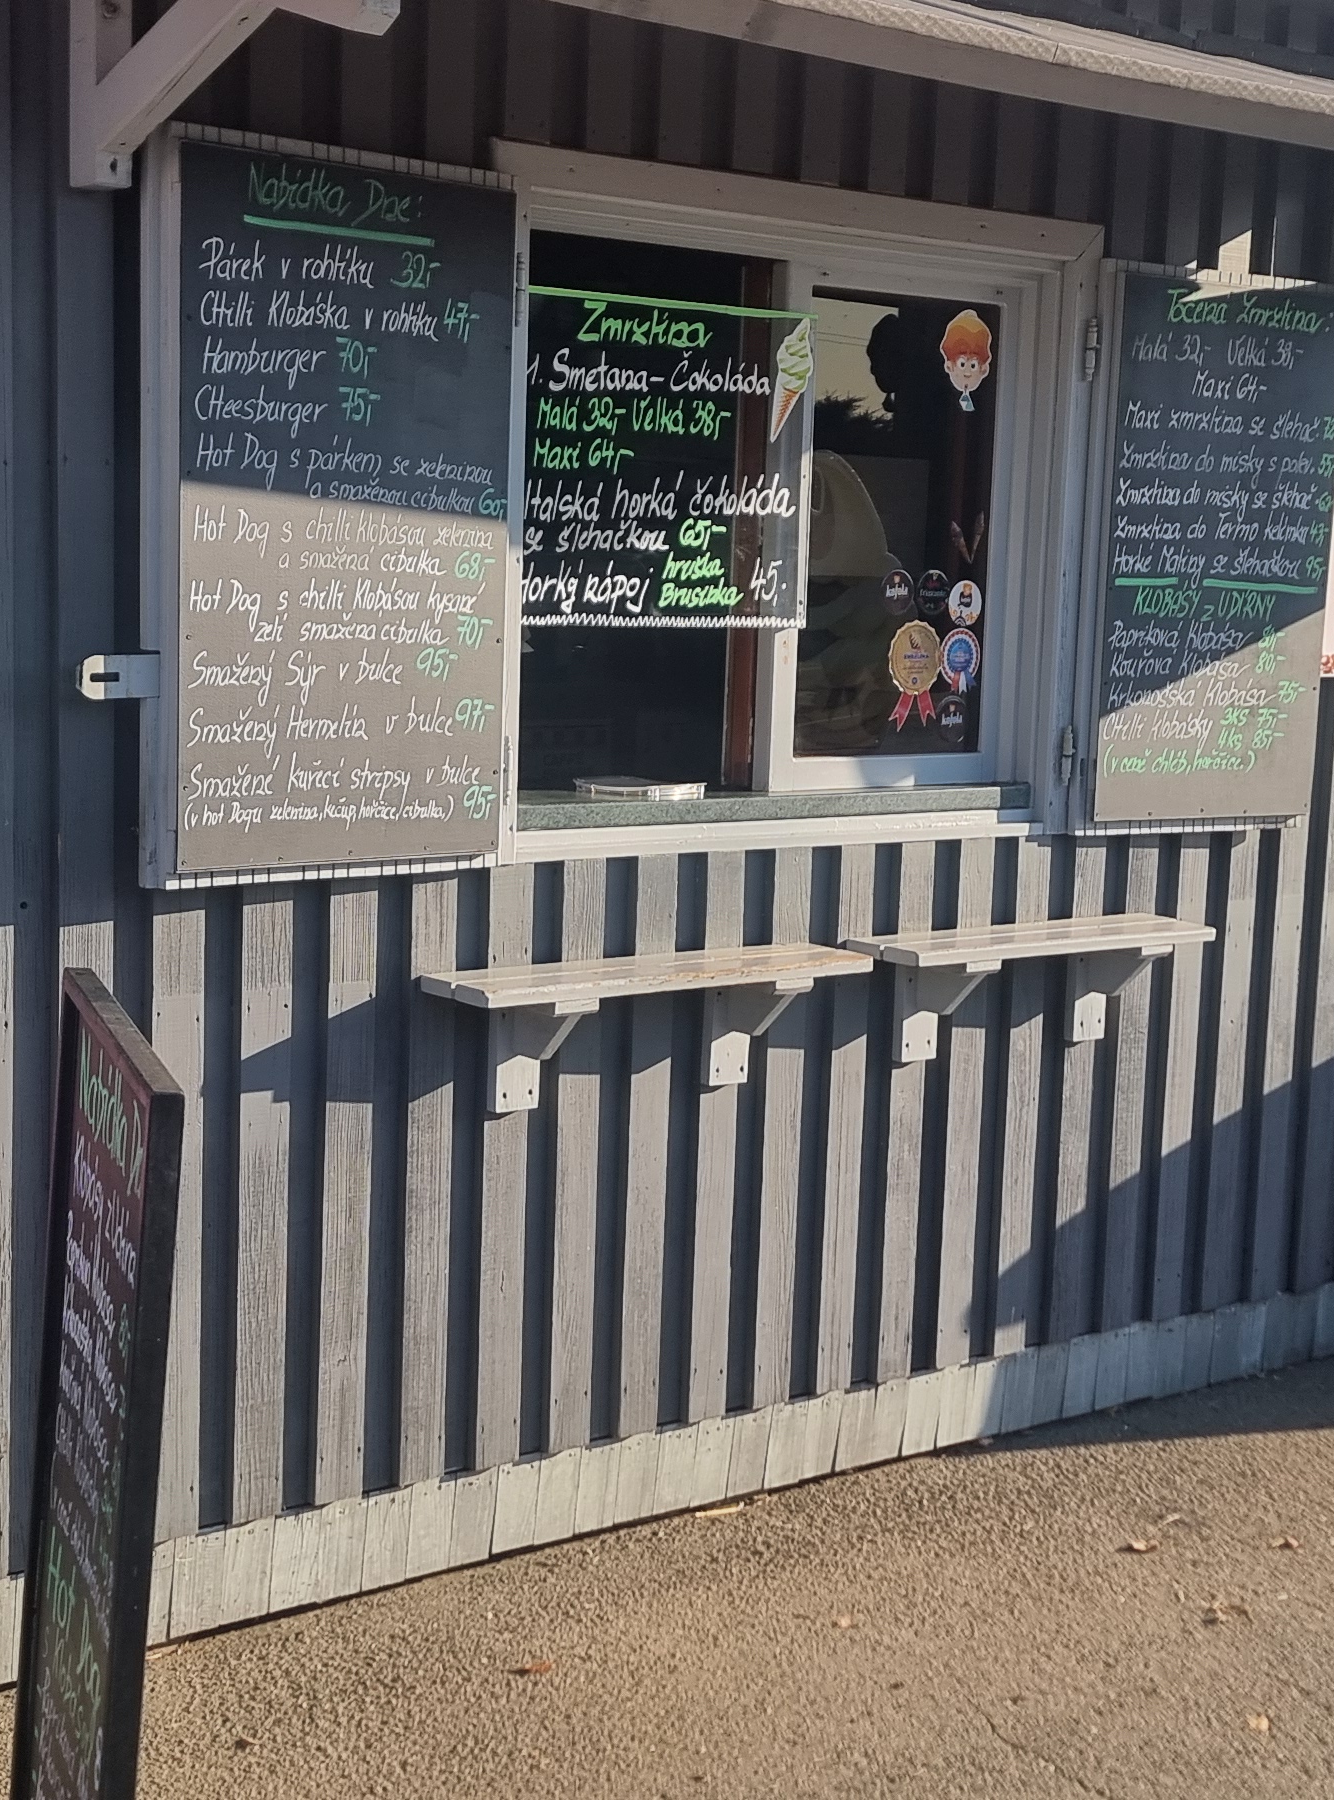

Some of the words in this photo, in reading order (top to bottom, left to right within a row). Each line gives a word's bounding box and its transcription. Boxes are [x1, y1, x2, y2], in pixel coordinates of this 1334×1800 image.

[248, 161, 353, 218] Nabídka
[200, 236, 272, 281] Párek
[303, 243, 374, 289] rohlíku
[382, 302, 439, 341] rohlíku
[578, 300, 712, 348] Zmrzlina
[203, 335, 327, 390] Hamburger
[1132, 332, 1172, 362] Malá
[1228, 335, 1268, 367] Velká
[670, 351, 771, 396] Čokoláda
[1192, 370, 1234, 400] Maxi
[537, 396, 577, 430] Malá
[632, 395, 684, 435] Velká
[1124, 401, 1163, 430] Maxi
[1249, 418, 1265, 435] se
[196, 432, 235, 471] Hot
[241, 432, 278, 488] Dog
[290, 448, 300, 467] s
[306, 434, 383, 489] párkem
[390, 453, 409, 477] se
[534, 438, 580, 470] Maxi
[1195, 444, 1214, 472] do
[1268, 461, 1276, 472] s
[524, 479, 603, 522] Italská
[611, 470, 684, 520] horká
[689, 473, 796, 518] čokoláda
[1183, 481, 1200, 505] do
[193, 504, 226, 542] Hot
[236, 507, 269, 557] Dog
[281, 521, 293, 542] s
[306, 506, 351, 542] chilli
[524, 526, 543, 556] se
[556, 520, 669, 552] šlehačkou
[1187, 515, 1206, 538] do
[380, 548, 446, 575] cibulka
[662, 552, 724, 581] hruška
[1113, 542, 1152, 574] Horké
[190, 579, 222, 613] Hot
[226, 579, 261, 632] Dog
[277, 590, 289, 609] s
[299, 578, 347, 611] chilli
[584, 560, 654, 613] nápoj
[886, 583, 908, 600] kofola
[381, 619, 449, 646] cibulka
[188, 650, 274, 706] Smažený
[285, 651, 326, 705] Sýr
[355, 648, 402, 685] bulce
[187, 705, 280, 759] Smažený
[286, 704, 369, 741] Hermelín
[386, 713, 395, 734] v
[404, 696, 453, 736] bulce
[188, 754, 280, 799] Smažené
[288, 751, 344, 794] kuřecí
[351, 758, 411, 799] stripsy
[436, 756, 479, 786] bulce
[204, 800, 225, 827] hot
[228, 801, 261, 833] Dogu
